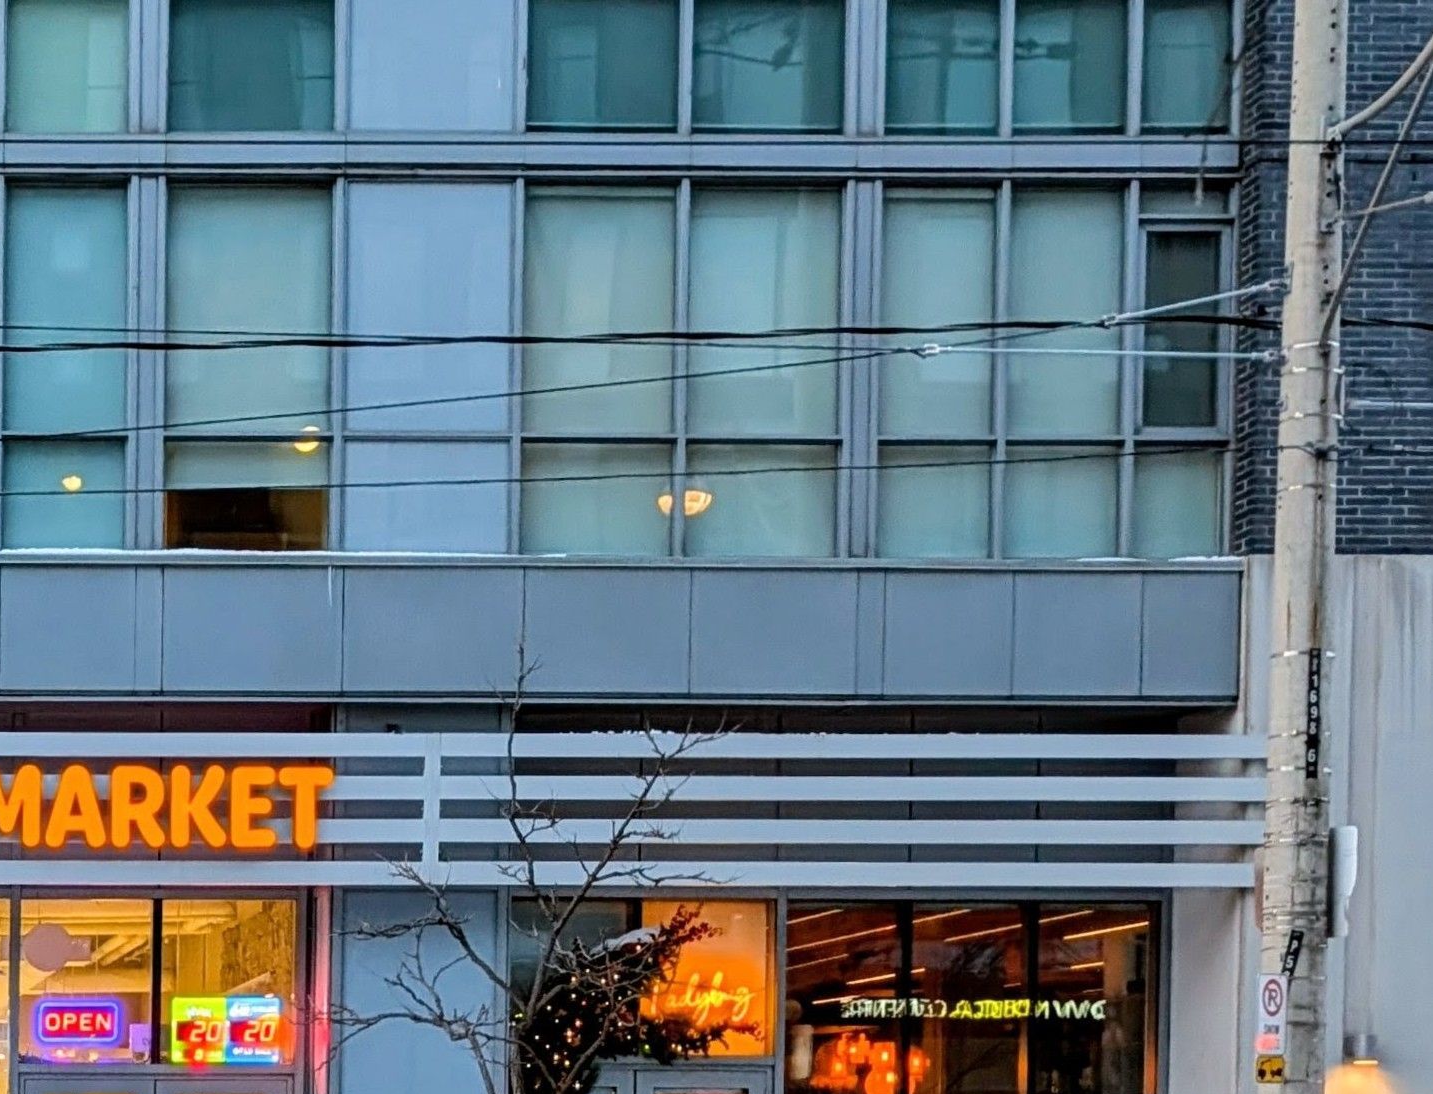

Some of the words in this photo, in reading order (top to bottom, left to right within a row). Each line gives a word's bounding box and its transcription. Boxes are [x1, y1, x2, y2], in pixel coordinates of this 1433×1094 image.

[1307, 749, 1316, 762] 6
[45, 1012, 112, 1031] OPEN
[189, 1021, 223, 1042] 20
[243, 1021, 276, 1042] 20
